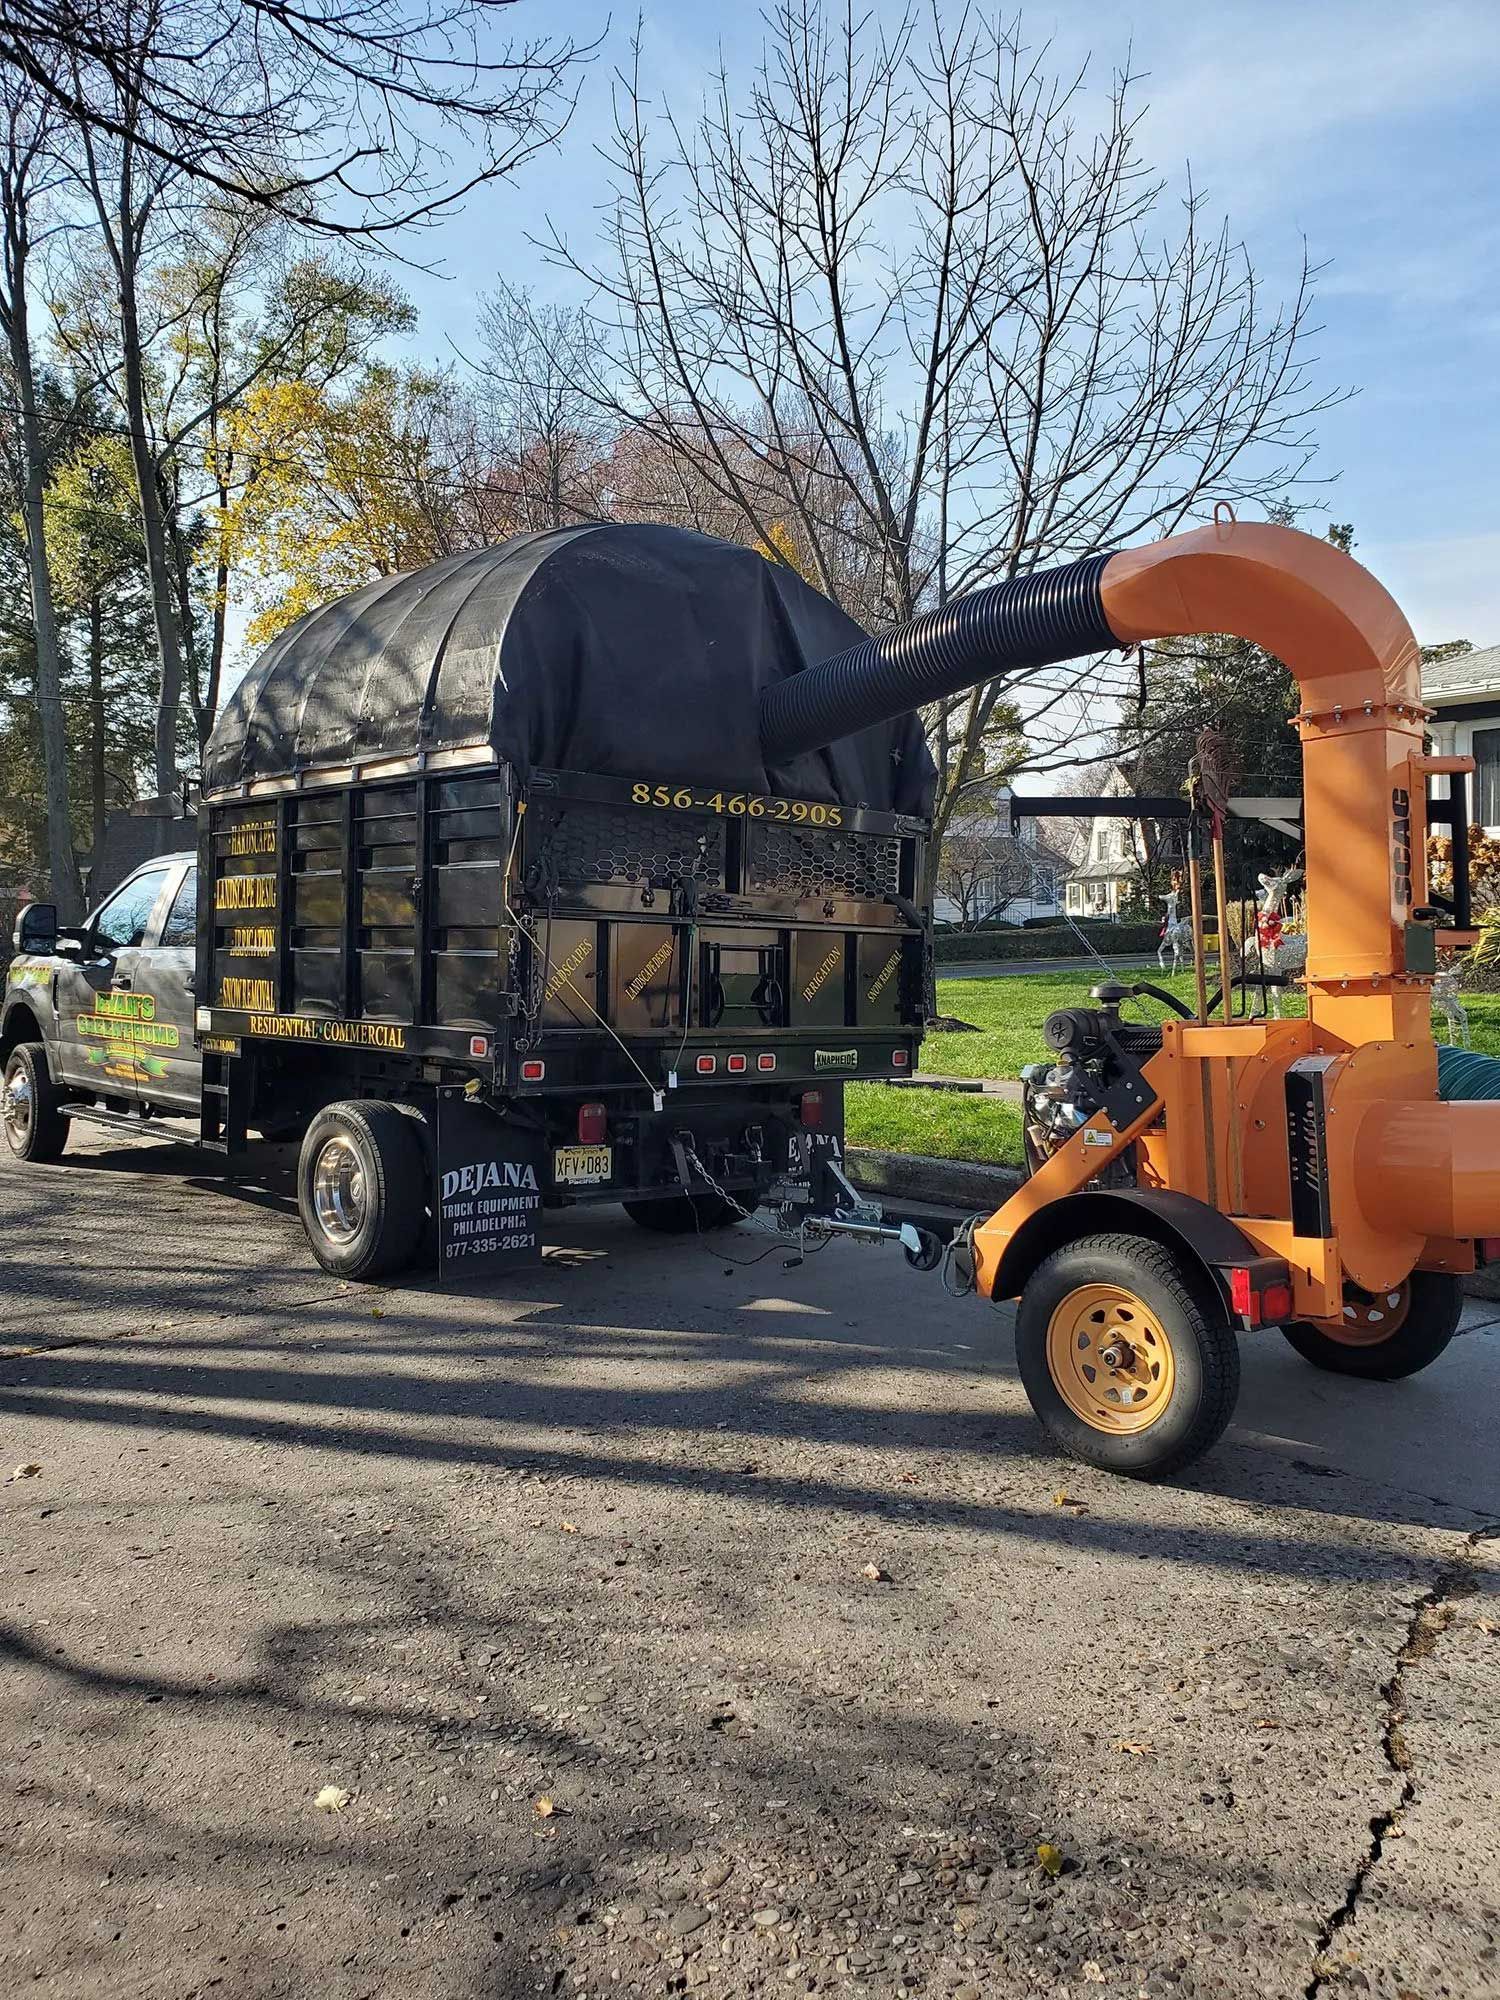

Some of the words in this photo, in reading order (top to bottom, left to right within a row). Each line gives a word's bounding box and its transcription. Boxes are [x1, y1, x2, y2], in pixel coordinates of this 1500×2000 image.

[631, 783, 843, 827] 856-466-2905
[231, 820, 276, 855] HARDSCAPES
[1392, 787, 1412, 906] SCAG
[216, 877, 255, 910] LANDSCAPE
[625, 959, 658, 1001] LANDSCAPE
[651, 940, 674, 969] DESIGN
[802, 946, 841, 1003] IRRIGATION
[867, 977, 884, 1003] SNOW
[878, 949, 903, 984] REMOVAL
[242, 978, 275, 1012] REMOVAL
[250, 1015, 318, 1039] RESIDENTIAL
[323, 1021, 406, 1049] COMMERCIAL
[816, 1052, 857, 1067] KNAPHEIDE
[441, 1161, 540, 1200] DEJANA
[557, 1157, 579, 1177] XFV
[587, 1155, 609, 1175] D83
[442, 1202, 473, 1219] TRUCK
[477, 1195, 541, 1215] EQUIPMENT
[453, 1215, 527, 1236] PHILADELPHIA
[446, 1233, 536, 1258] 877-335-2621
